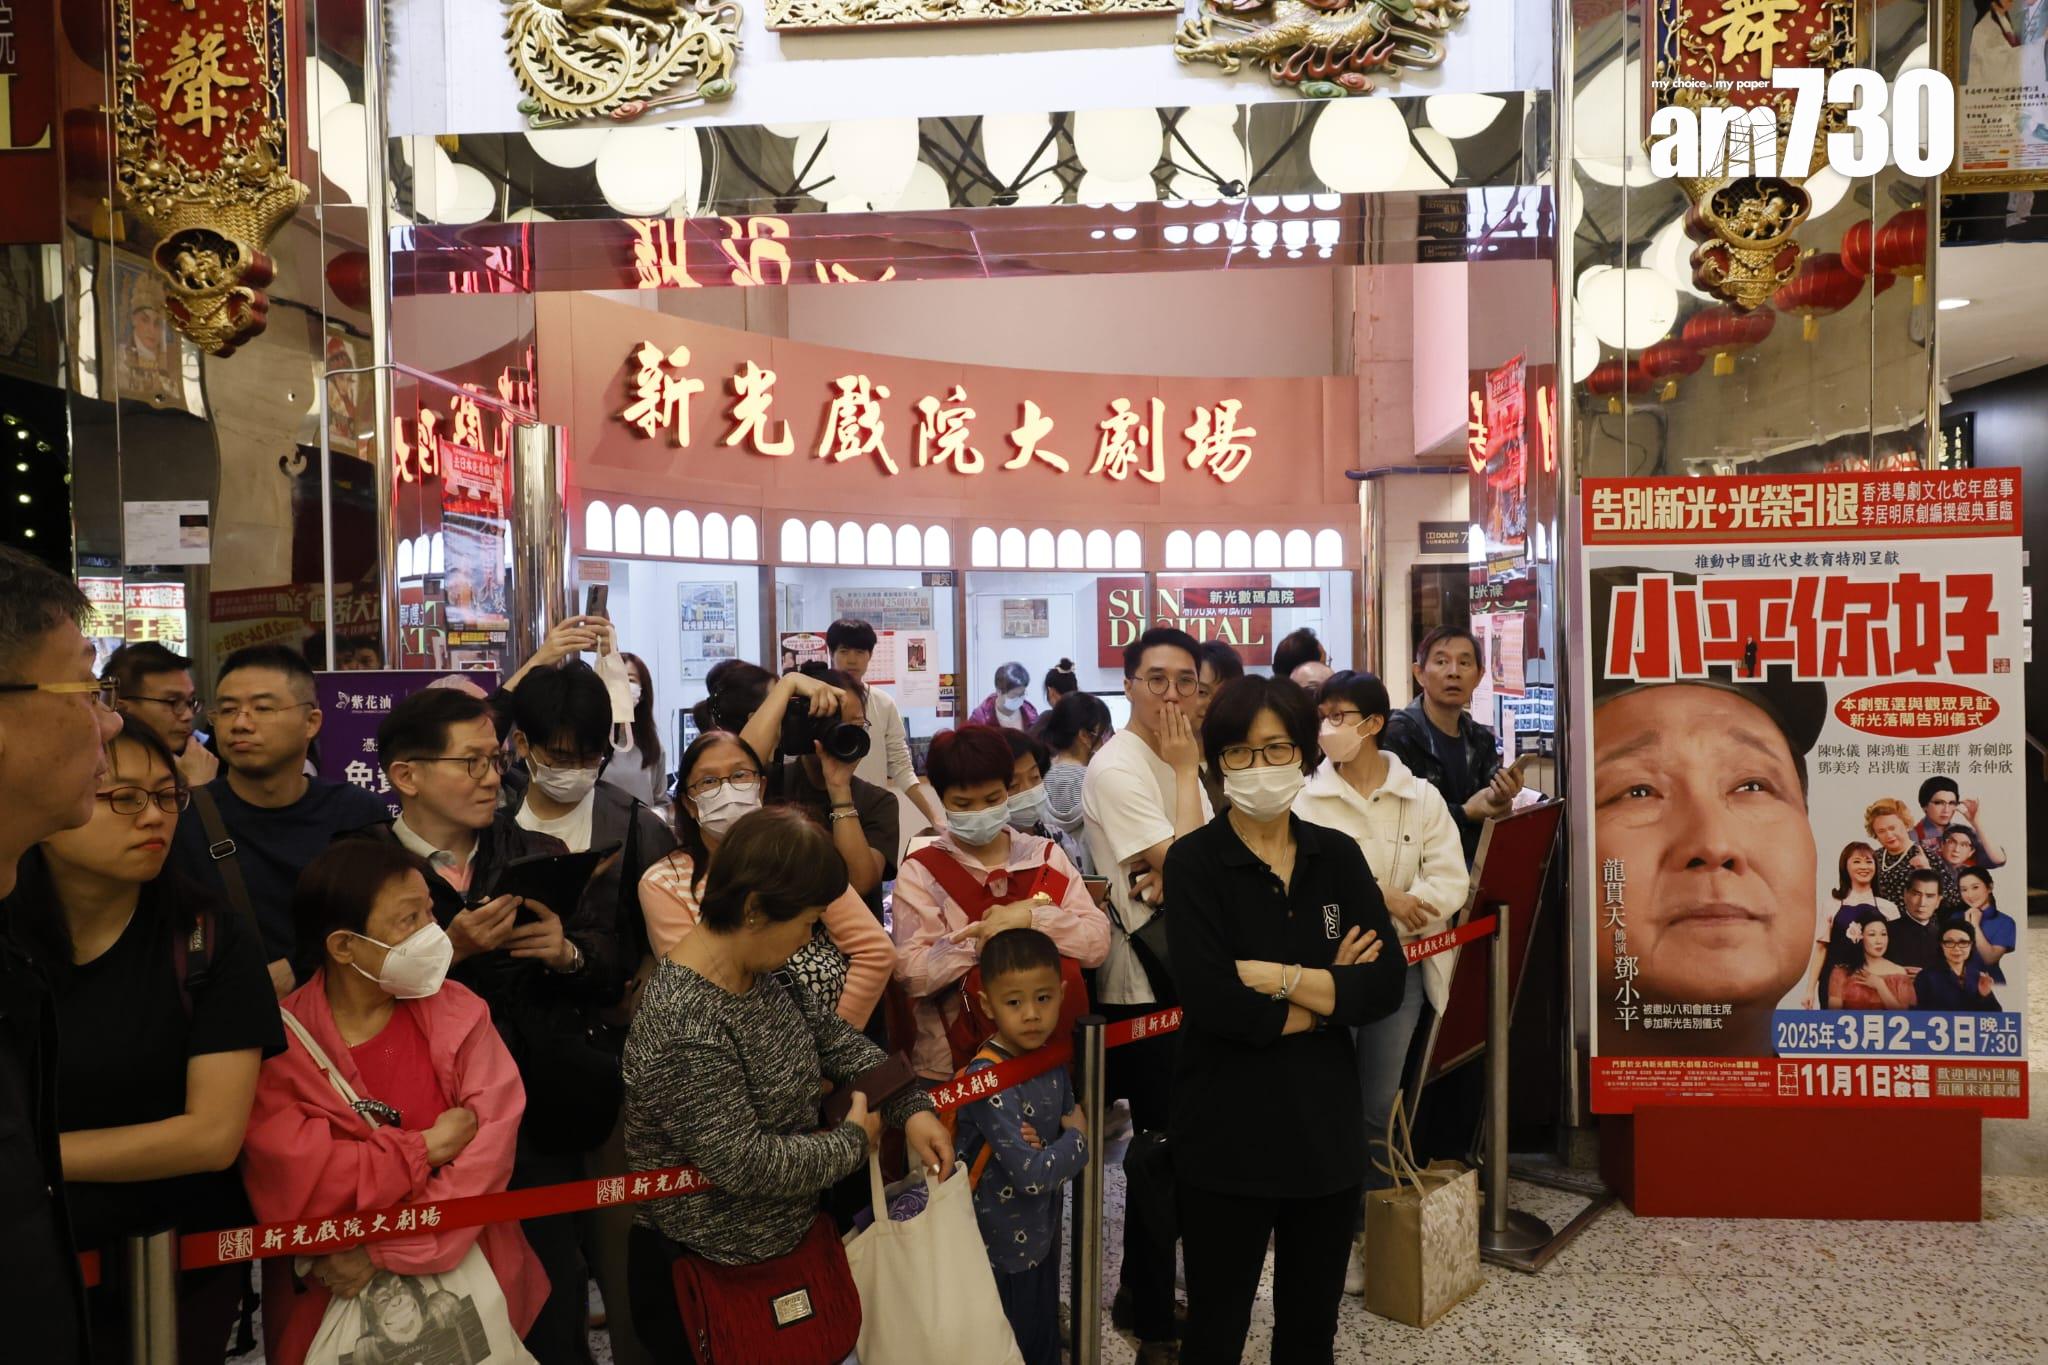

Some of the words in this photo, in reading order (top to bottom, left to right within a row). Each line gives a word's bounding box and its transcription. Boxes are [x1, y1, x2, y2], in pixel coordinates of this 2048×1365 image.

[1701, 0, 1800, 79] 舞
[161, 30, 249, 138] 聲
[622, 340, 1257, 484] 新光戲院大劇場
[1862, 478, 2015, 503] 香港粵劇文化蛇年盛事
[1861, 500, 2014, 526] 李居明原創編撰經典重臨
[1695, 550, 1900, 570] 推動中國近代史教育特別呈獻
[1210, 590, 1295, 605] 新光數碼戲院
[1608, 572, 2000, 679] 小平你好
[351, 694, 392, 710] 紫花油
[939, 687, 954, 695] VISA
[362, 738, 378, 753] 憑
[1603, 858, 1626, 929] 龍貫天
[1614, 955, 1640, 1031] 鄧小平
[1777, 1014, 1976, 1053] 2025年3月2-3日
[1979, 1017, 2017, 1033] 晚上
[1980, 1033, 2019, 1053] 7:30
[1801, 1064, 1891, 1097] 11月1日
[261, 1206, 442, 1252] 新光戲院大劇場
